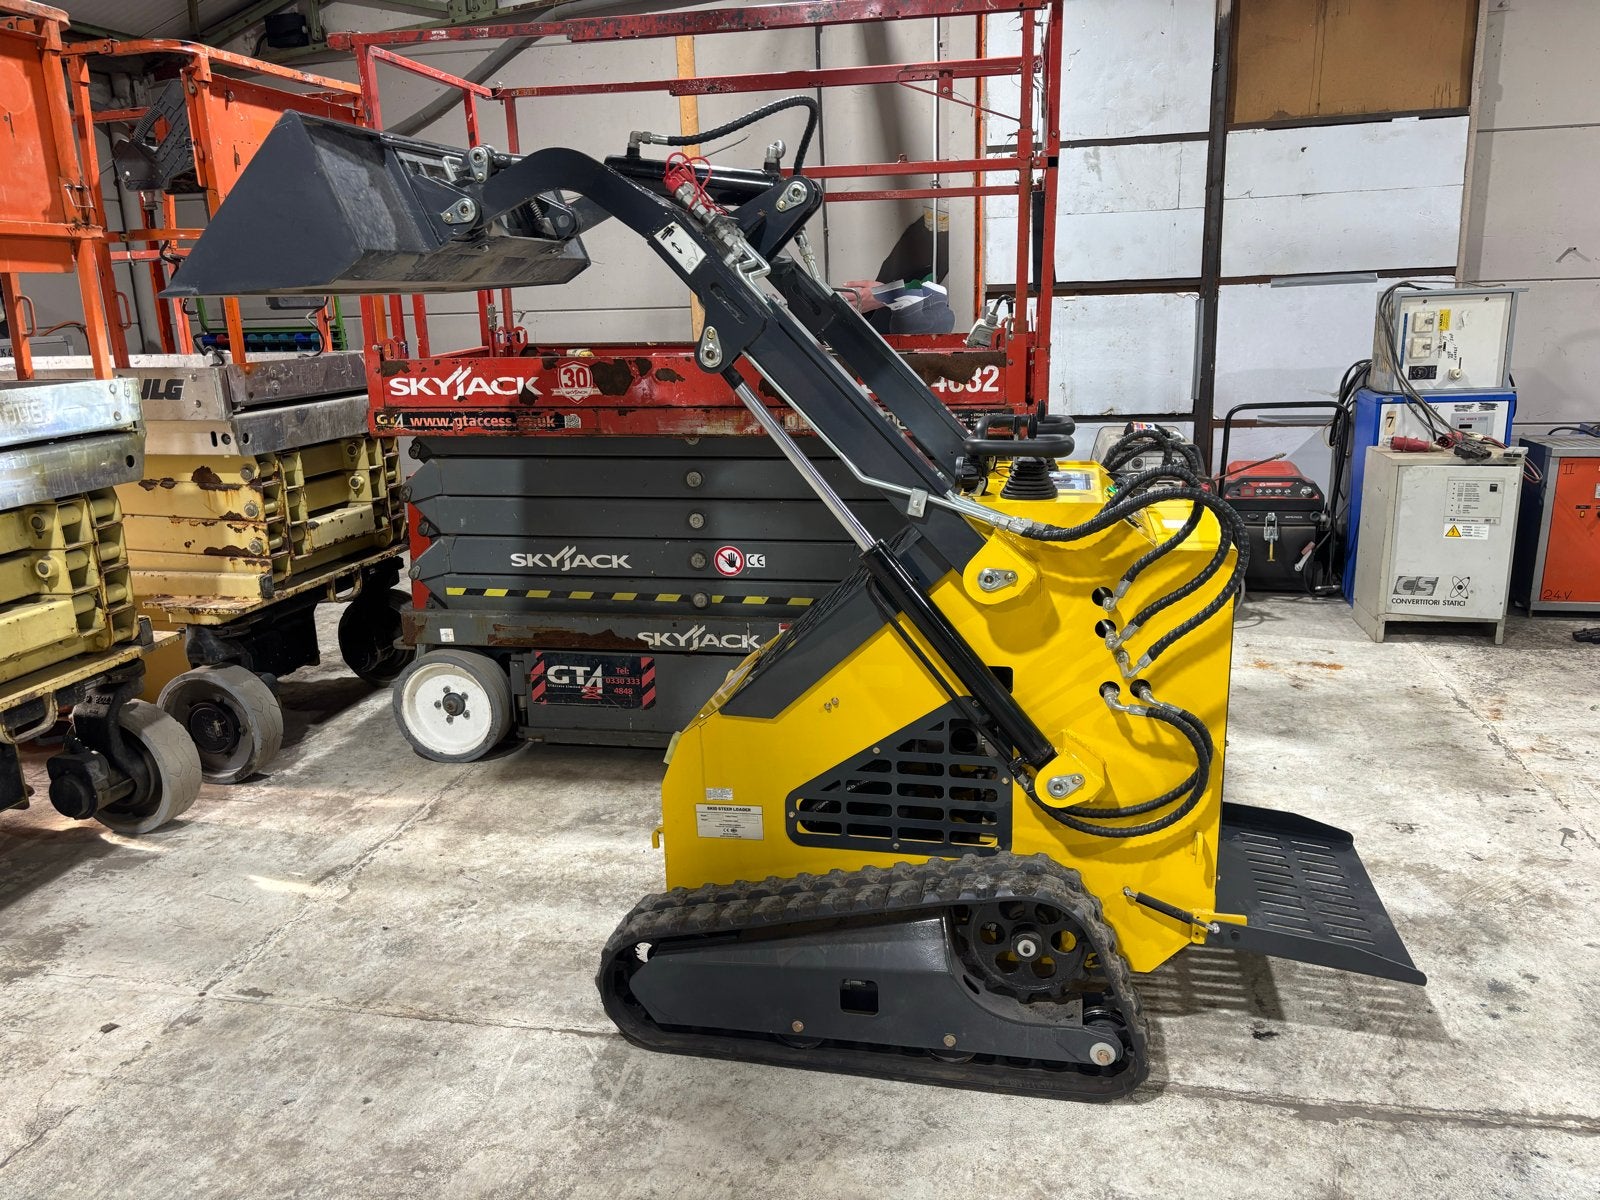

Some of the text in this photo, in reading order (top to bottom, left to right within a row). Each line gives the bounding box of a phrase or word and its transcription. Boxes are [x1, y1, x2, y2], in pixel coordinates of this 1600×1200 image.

[389, 365, 543, 400] SKYJACK
[563, 367, 588, 388] 30
[141, 378, 185, 400] JLG
[1386, 416, 1395, 428] 7
[510, 546, 632, 571] SKYJACK
[748, 554, 764, 566] CE
[1392, 576, 1439, 596] CS
[1442, 599, 1466, 607] STATICI
[637, 624, 761, 651] SKYJACK
[546, 664, 603, 694] GTA
[615, 667, 630, 675] Tel:
[605, 677, 641, 686] 0330 333
[613, 687, 634, 695] 4848
